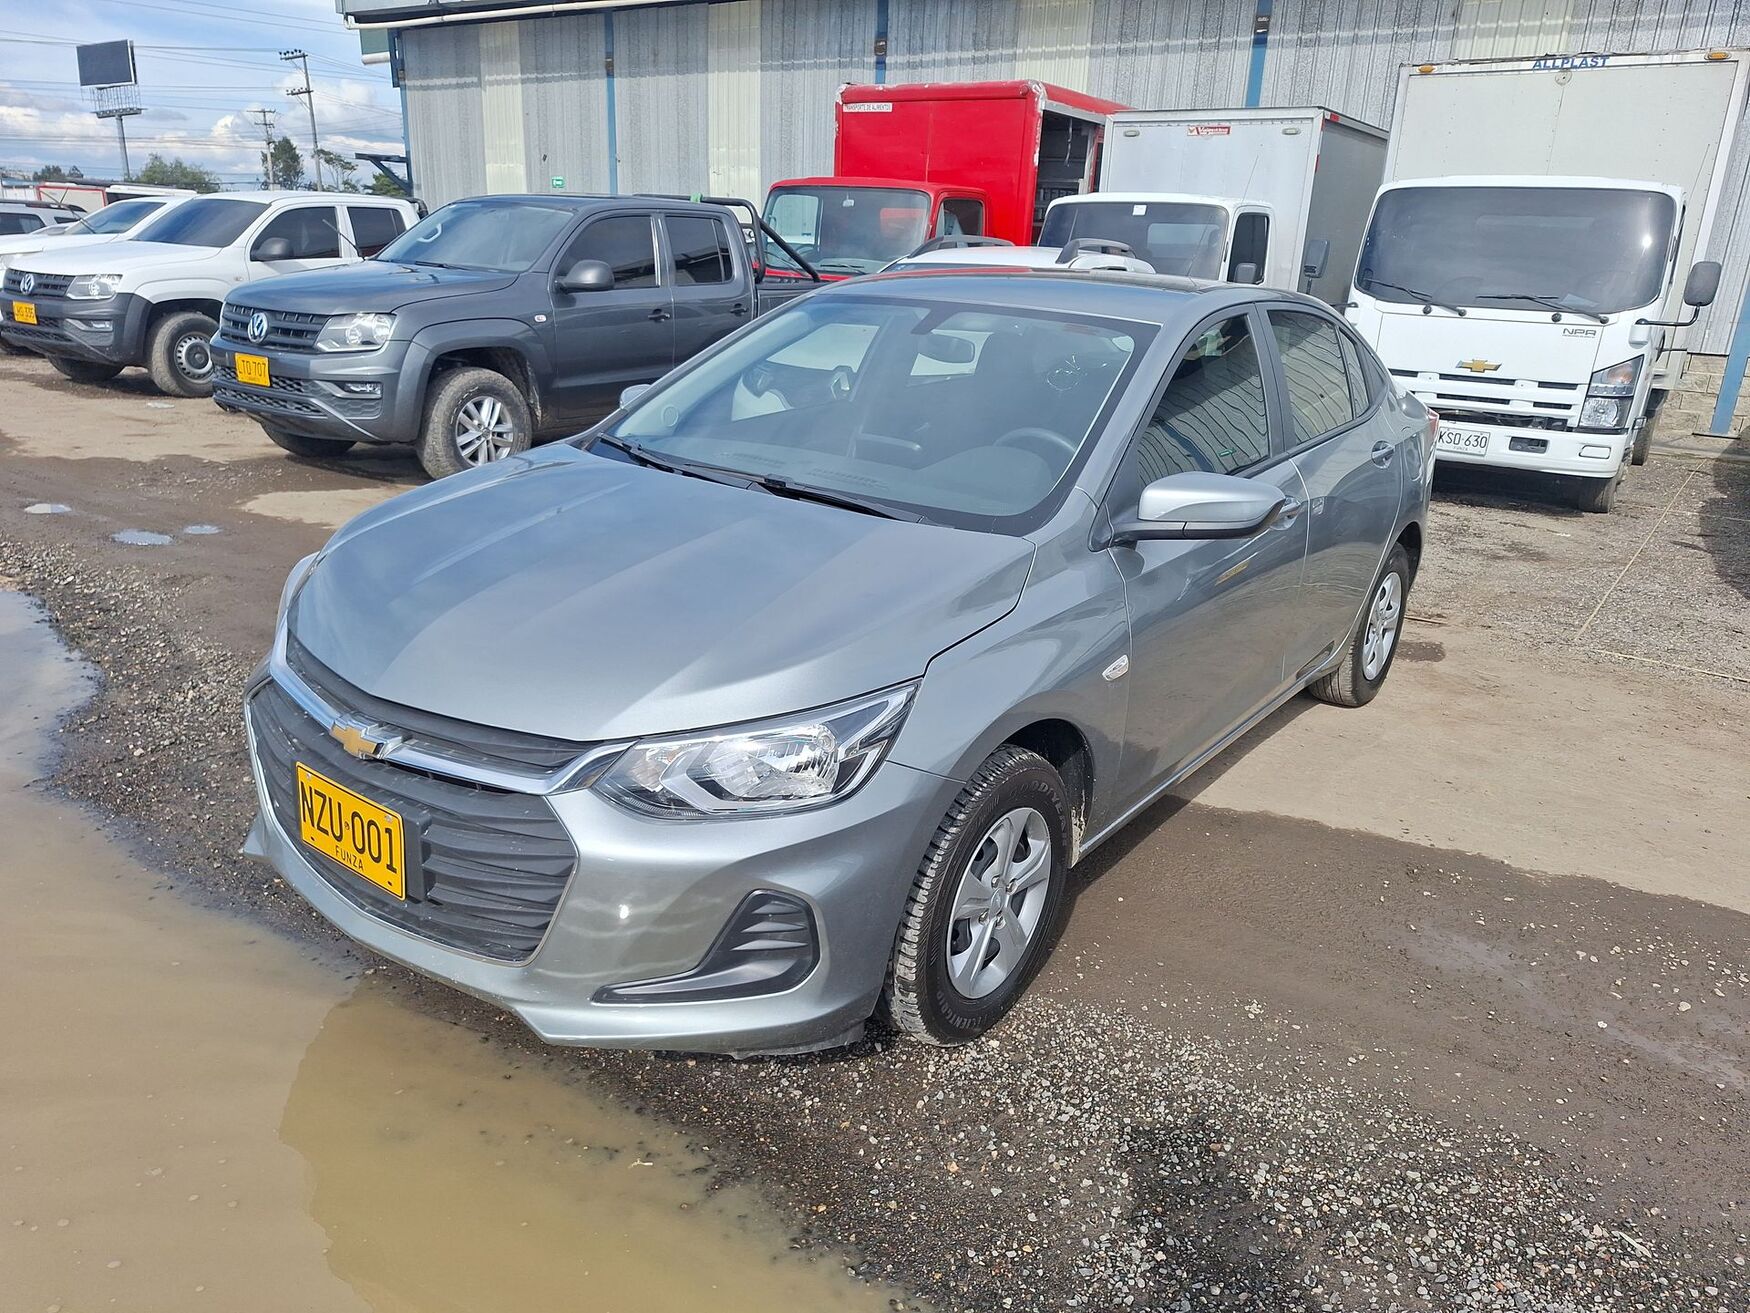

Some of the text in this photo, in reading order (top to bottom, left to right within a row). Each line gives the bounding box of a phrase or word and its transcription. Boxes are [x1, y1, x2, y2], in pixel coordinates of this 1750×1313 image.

[1532, 56, 1610, 69] ALLPLAST
[1563, 328, 1597, 336] NPR
[335, 845, 364, 871] FUNZA
